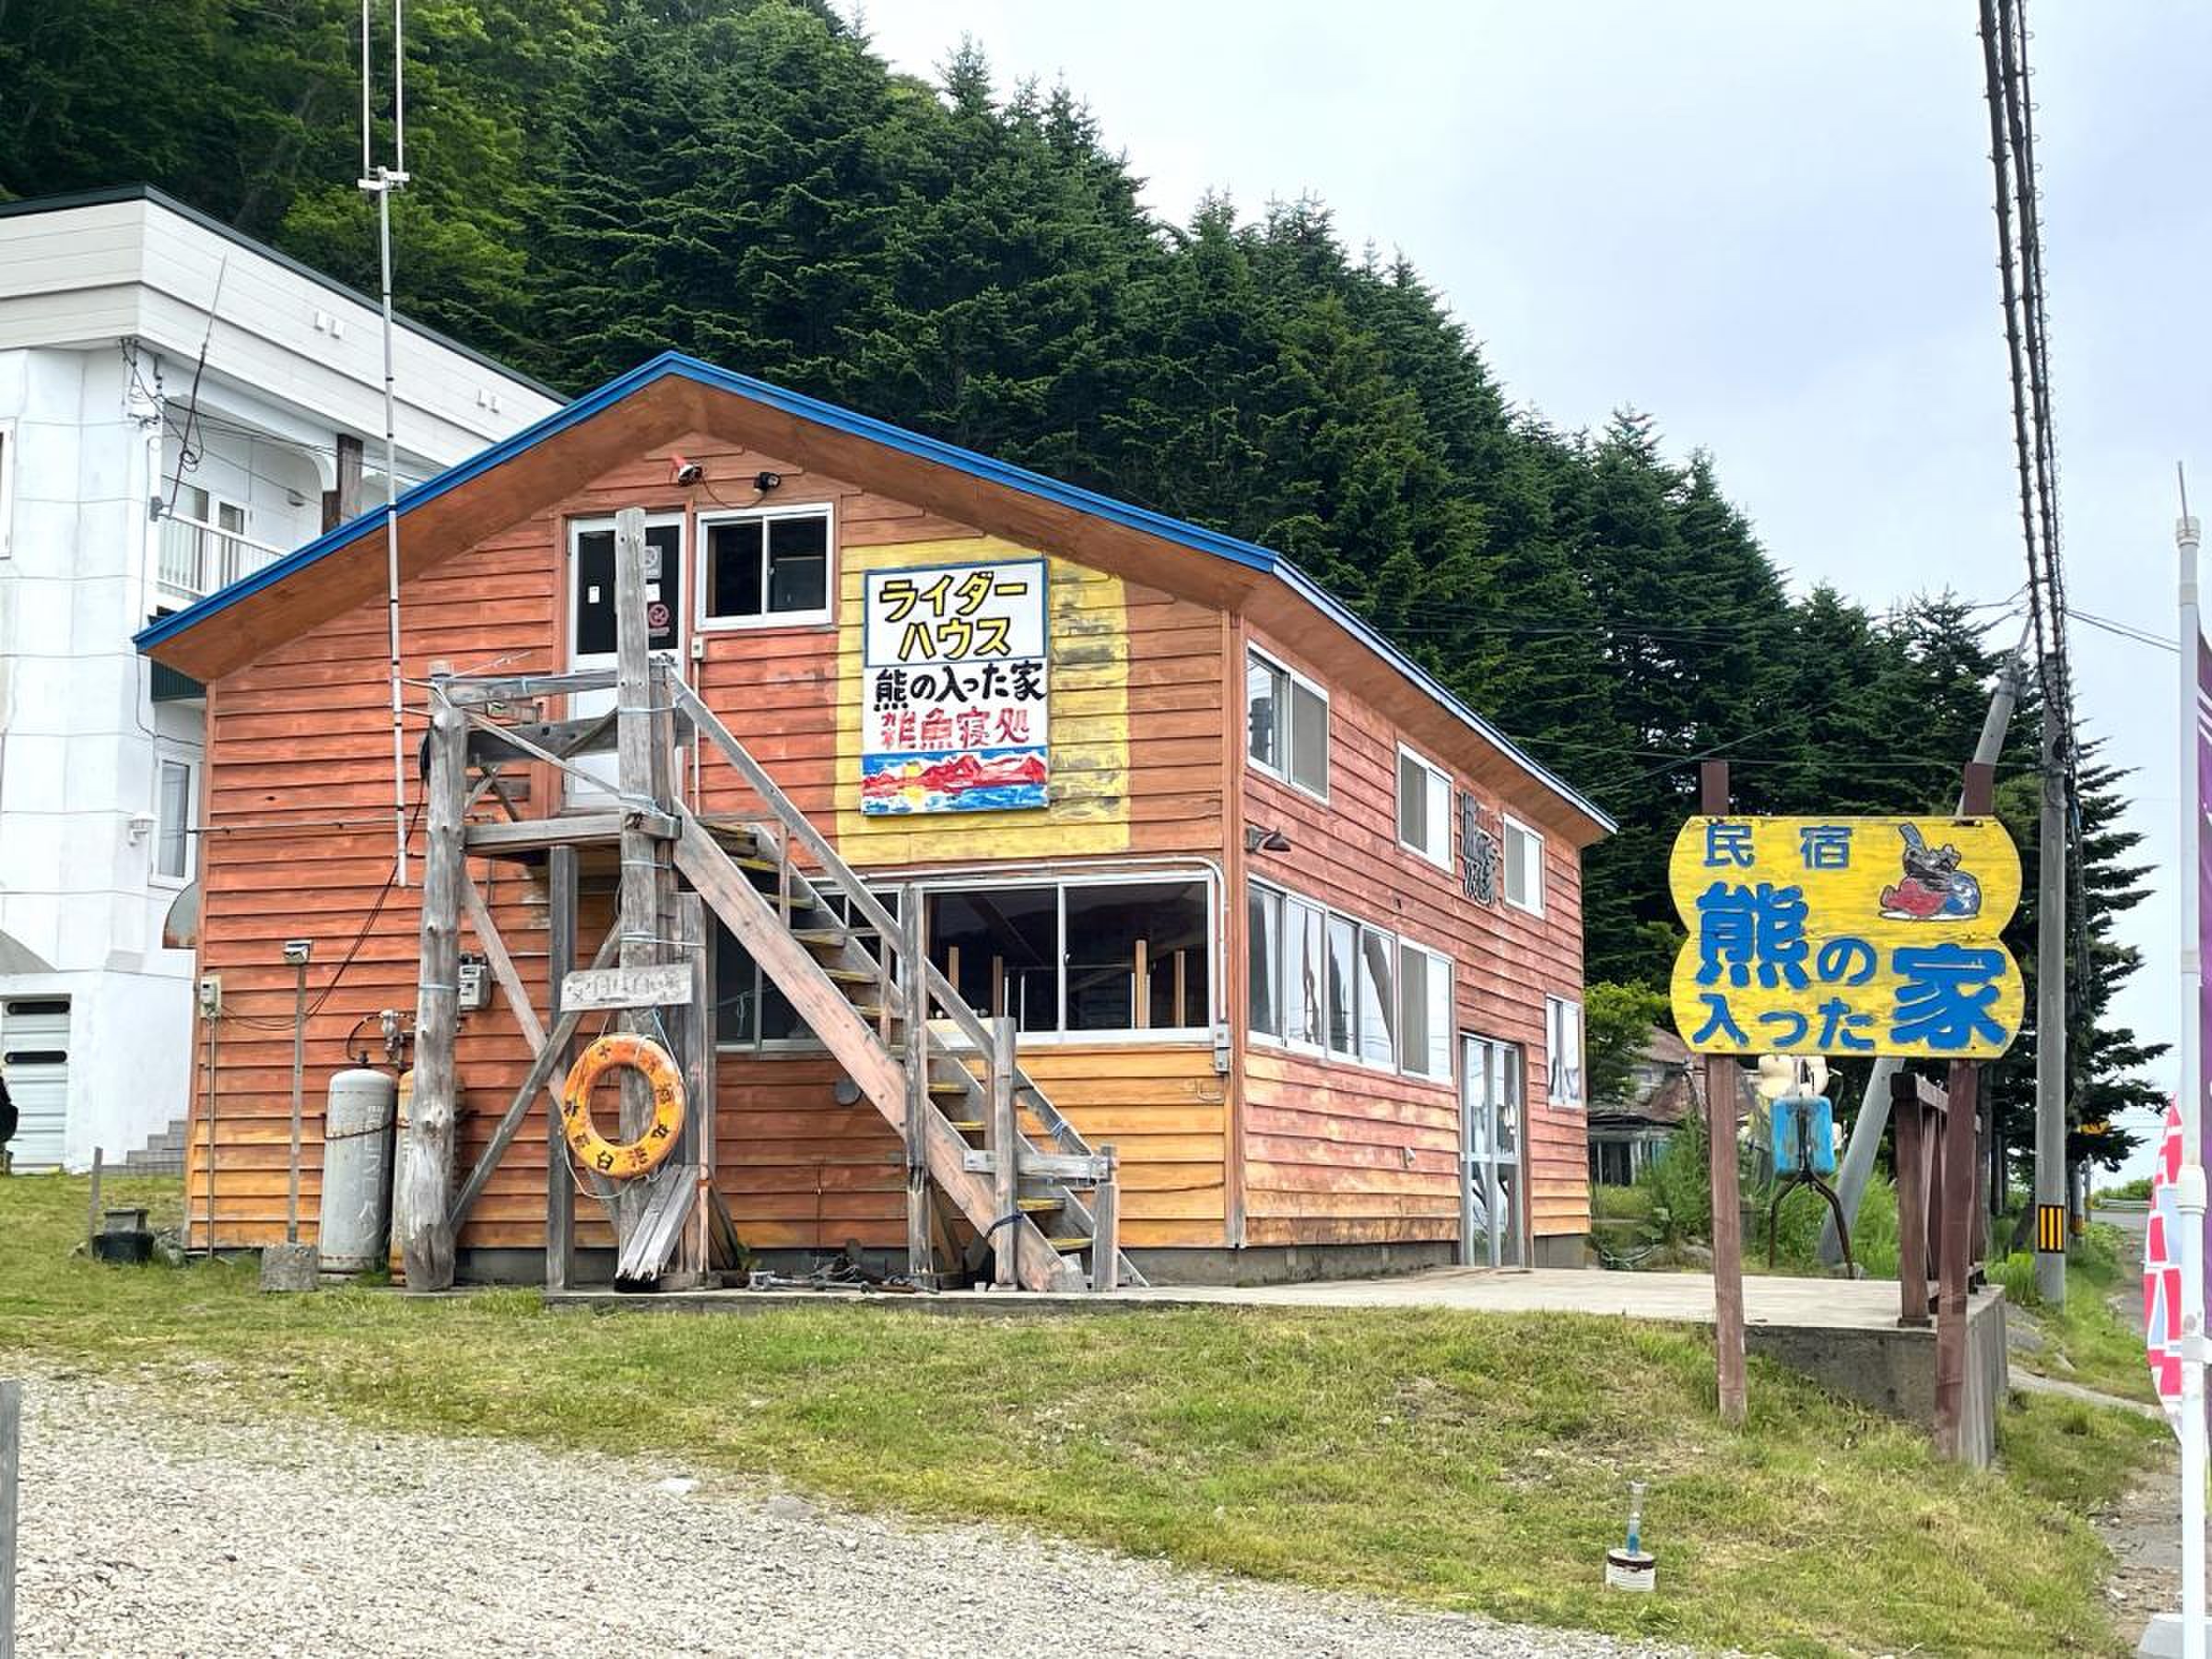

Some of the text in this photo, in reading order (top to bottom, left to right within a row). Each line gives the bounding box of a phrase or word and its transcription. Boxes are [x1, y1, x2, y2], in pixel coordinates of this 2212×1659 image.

[879, 571, 1028, 623] ライダー
[898, 617, 1011, 662] ハウス
[874, 659, 1048, 712] 熊の入った家
[1703, 824, 1854, 870] 民宿
